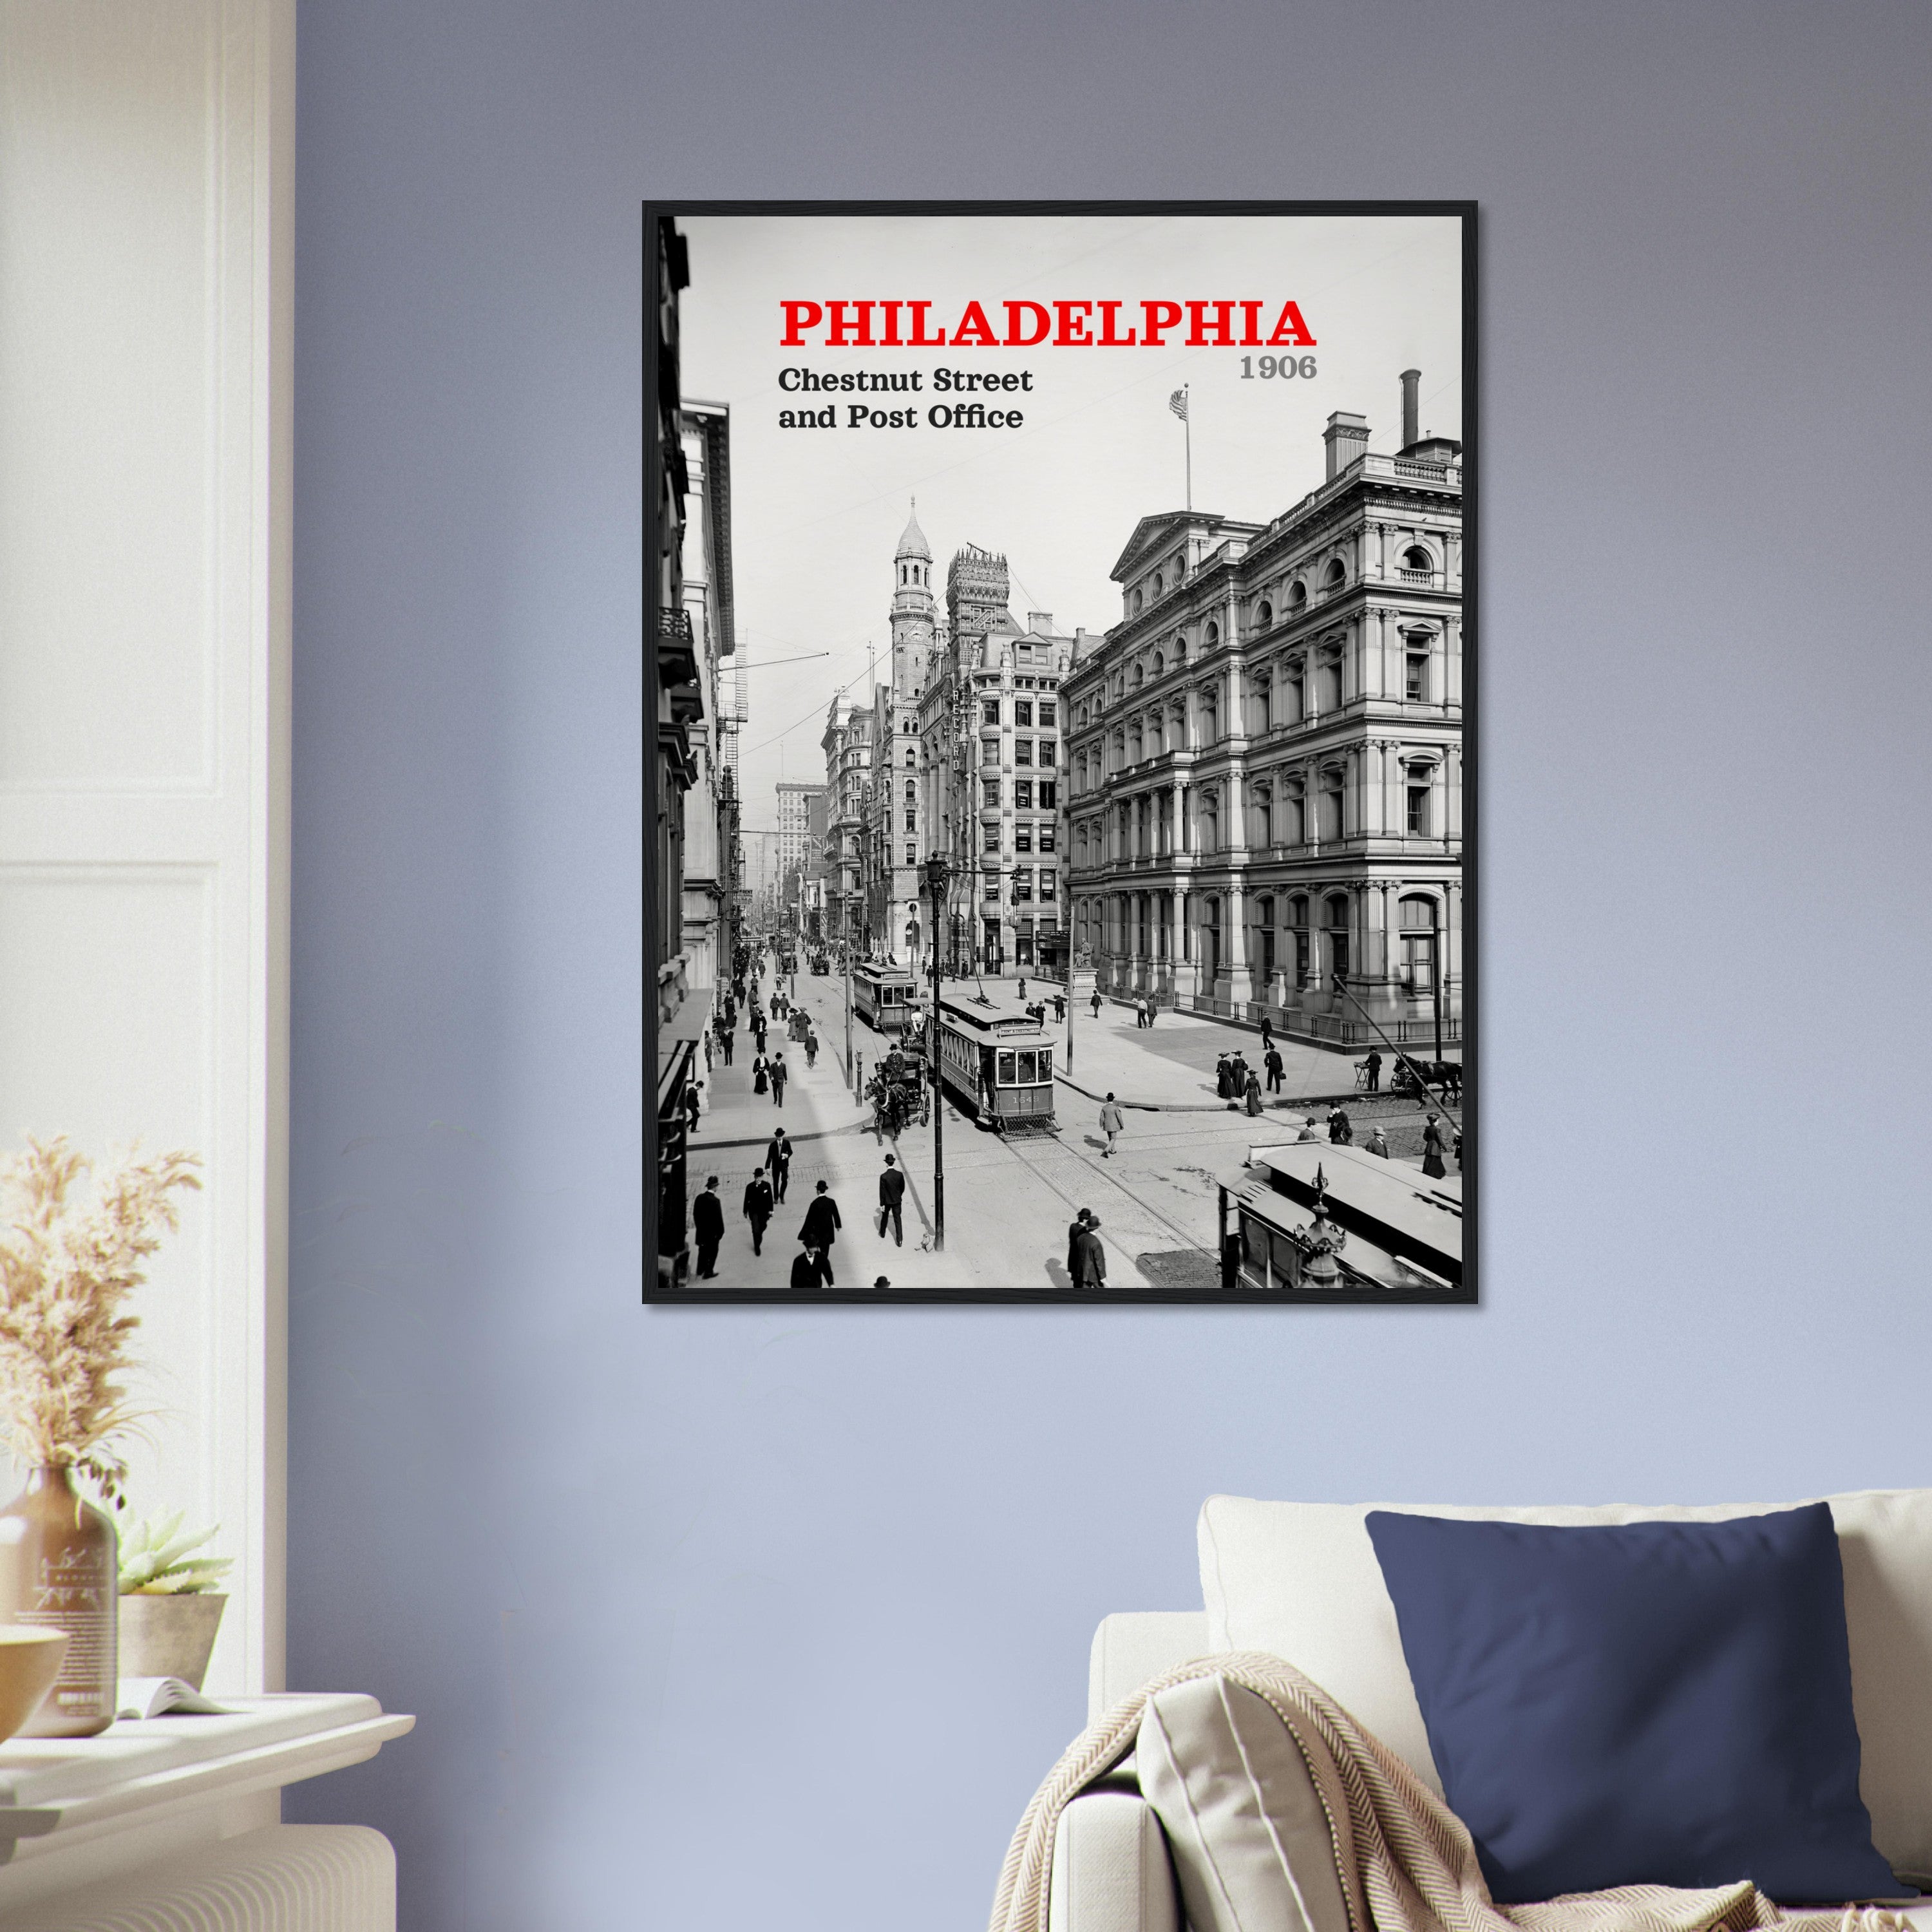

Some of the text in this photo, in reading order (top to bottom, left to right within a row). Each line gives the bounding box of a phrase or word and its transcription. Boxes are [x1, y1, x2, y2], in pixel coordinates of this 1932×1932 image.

[780, 300, 1317, 346] PHILADELPHIA
[1241, 356, 1317, 379] 1906
[779, 368, 1033, 392] Chestnut Street
[779, 404, 1023, 428] and Post Office
